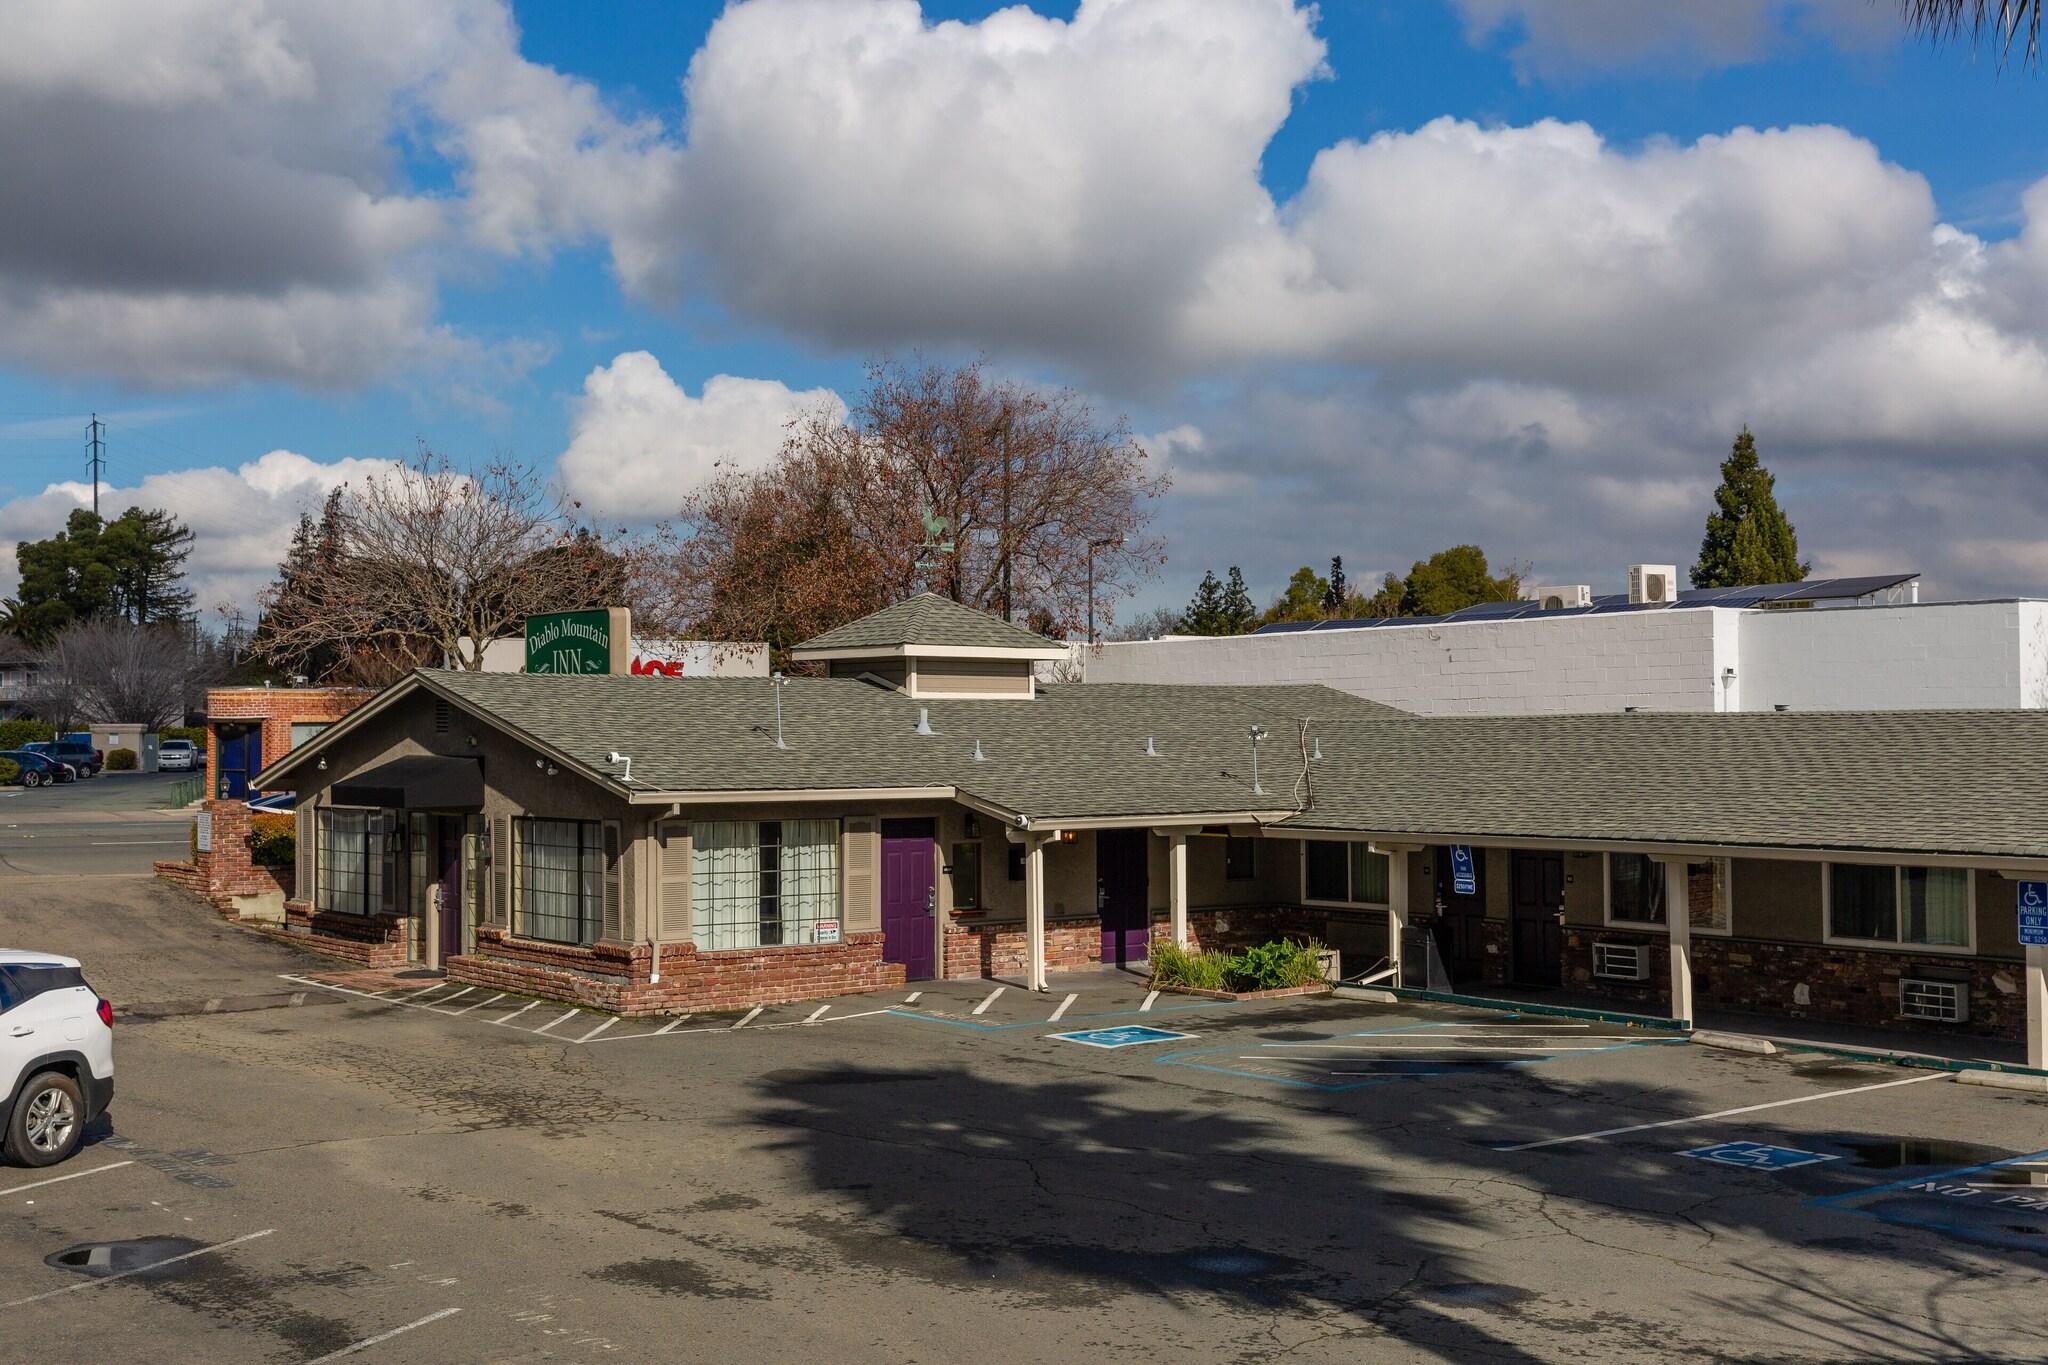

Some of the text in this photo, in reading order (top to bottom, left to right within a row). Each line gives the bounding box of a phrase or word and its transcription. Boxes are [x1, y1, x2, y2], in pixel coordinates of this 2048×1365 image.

[529, 617, 609, 656] Diablo Mountain
[552, 648, 582, 675] INN
[2020, 905, 2047, 916] PARKING
[2025, 916, 2042, 926] ONLY
[1908, 1182, 1982, 1197] NO
